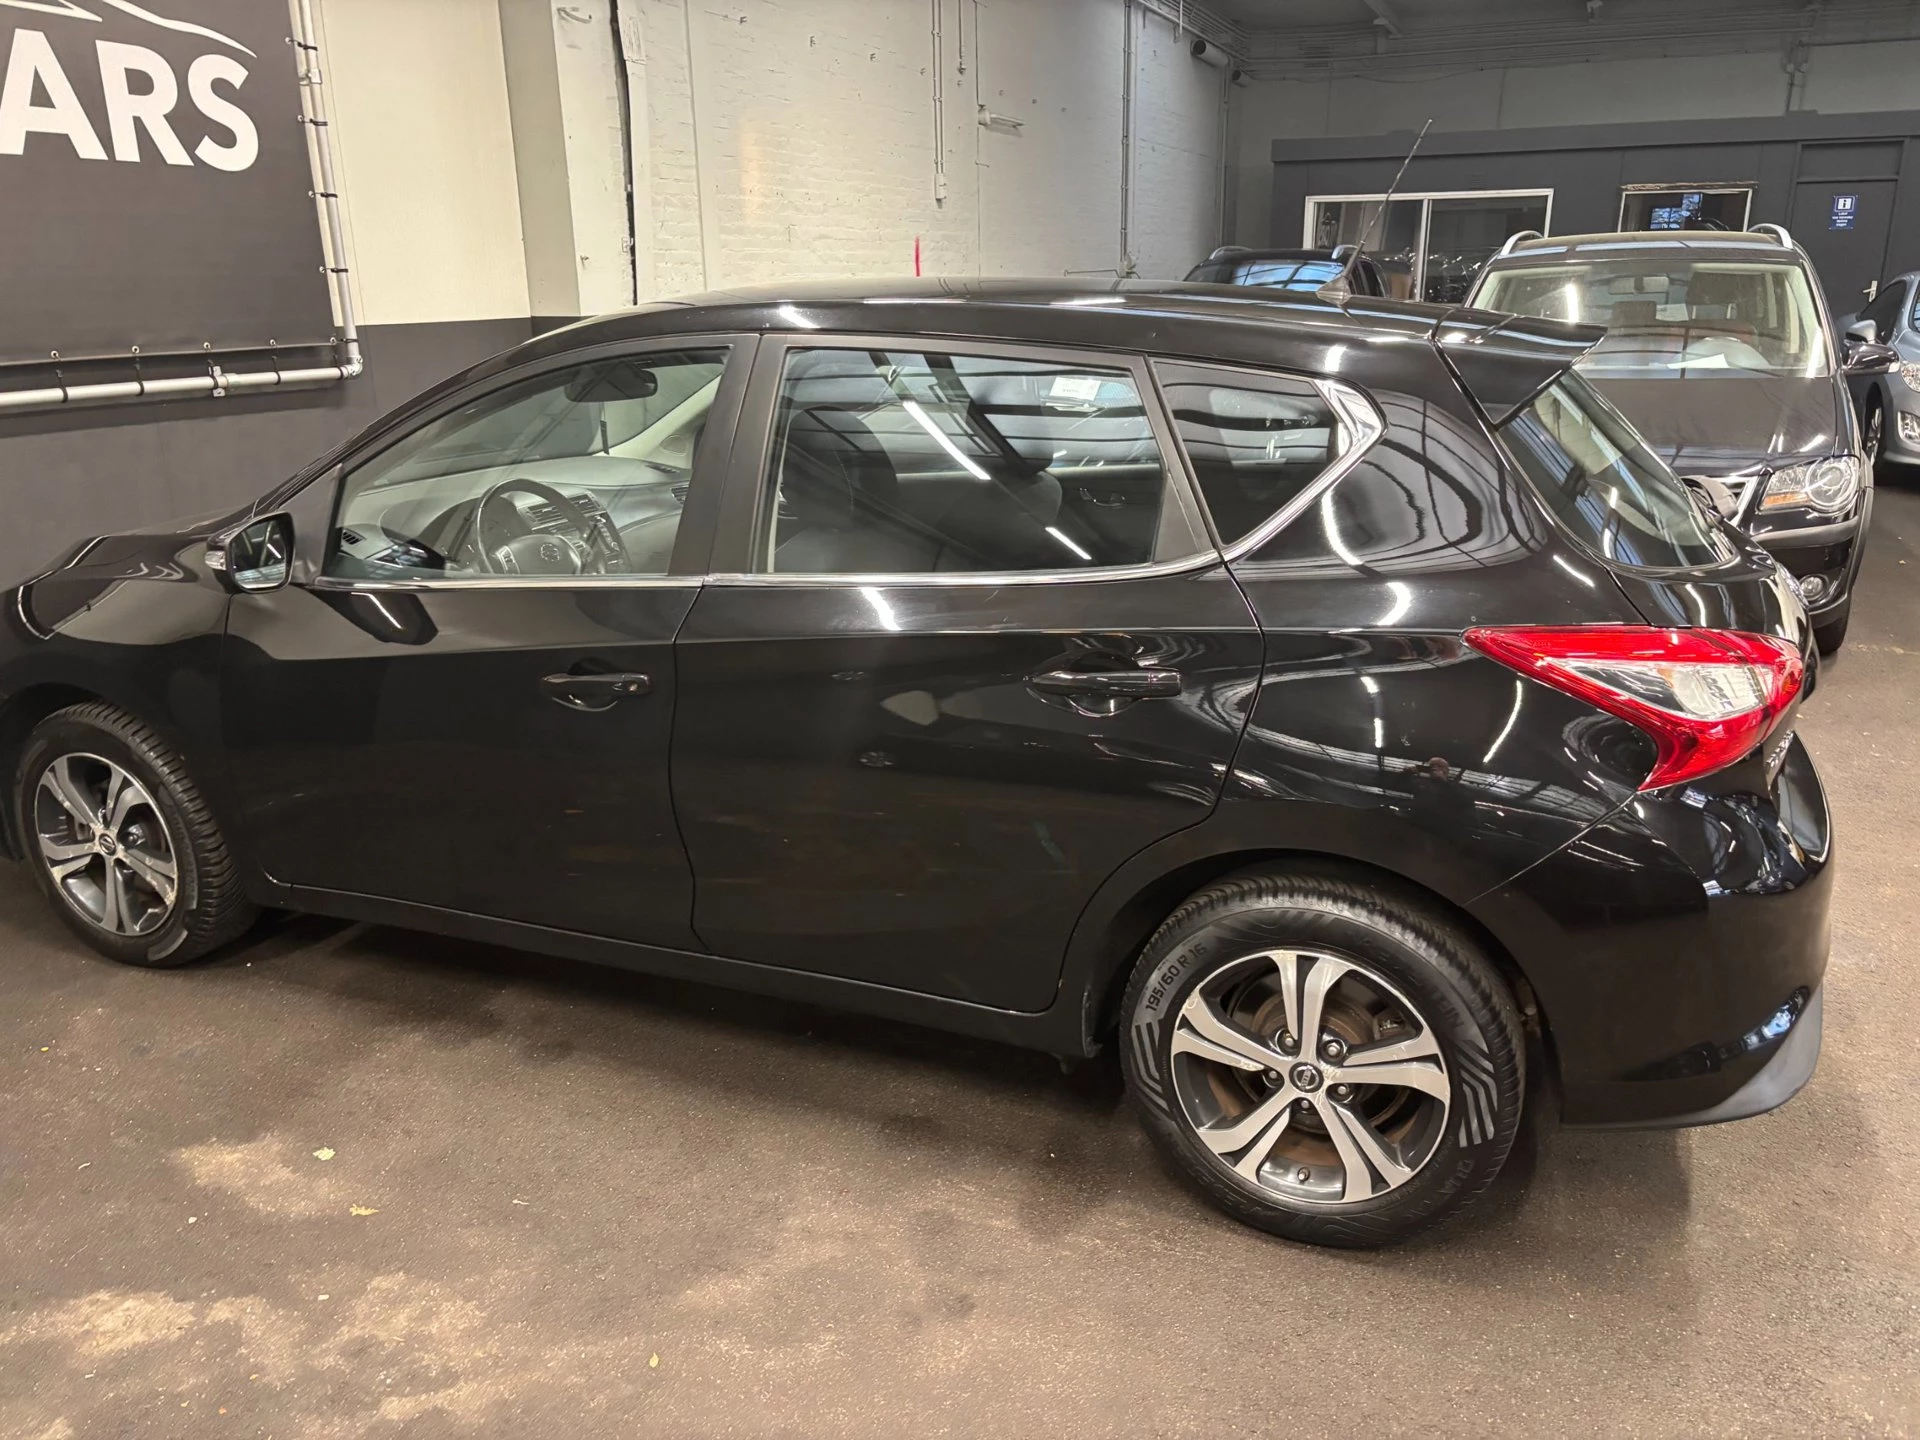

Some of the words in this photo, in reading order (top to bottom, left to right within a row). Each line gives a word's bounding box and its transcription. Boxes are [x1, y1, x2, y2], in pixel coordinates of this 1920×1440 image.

[0, 28, 259, 172] ARS
[1145, 964, 1181, 1012] 195/60
[1176, 954, 1191, 969] R
[1188, 943, 1208, 959] 16
